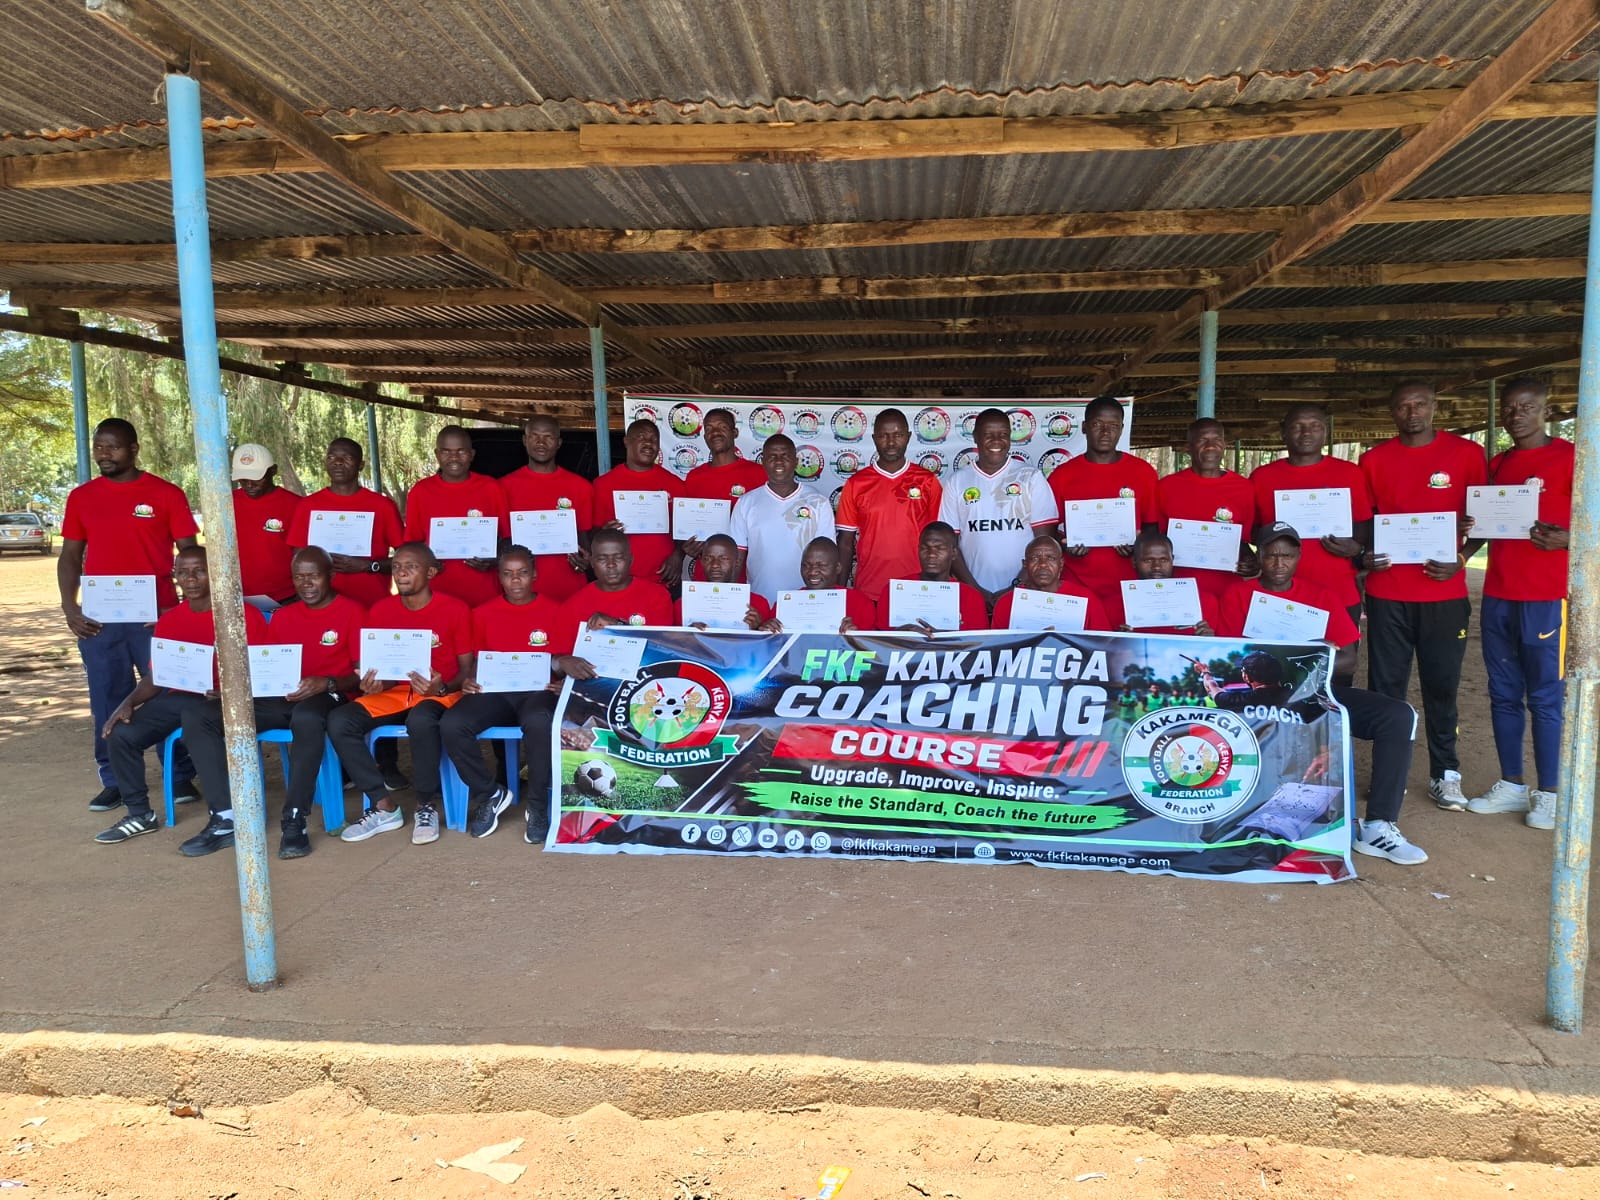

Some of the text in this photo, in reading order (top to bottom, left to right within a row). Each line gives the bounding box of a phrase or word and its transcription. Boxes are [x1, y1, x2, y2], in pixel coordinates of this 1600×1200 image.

[968, 518, 1024, 532] KENYA
[801, 647, 1109, 682] FKF KAKAMEGA
[615, 671, 652, 730] FOOTBALL
[705, 687, 725, 724] KENYA
[774, 682, 1107, 737] COACHING
[1243, 705, 1303, 725] COACH
[1136, 712, 1243, 739] KAKAMEGA
[620, 744, 711, 763] FEDERATION
[831, 730, 1004, 769] COURSE
[1152, 735, 1173, 785] FOOTBALL
[1217, 742, 1231, 776] KENYA
[810, 765, 1060, 799] Upgrade, Improve, Inspire.
[1160, 788, 1224, 798] FEDERATION
[790, 791, 1097, 824] Raise the Standard, Coach the future
[1164, 801, 1216, 815] BRANCH
[841, 838, 936, 854] @fkfkakamega
[1009, 848, 1171, 867] www.fkfkakamega.com
